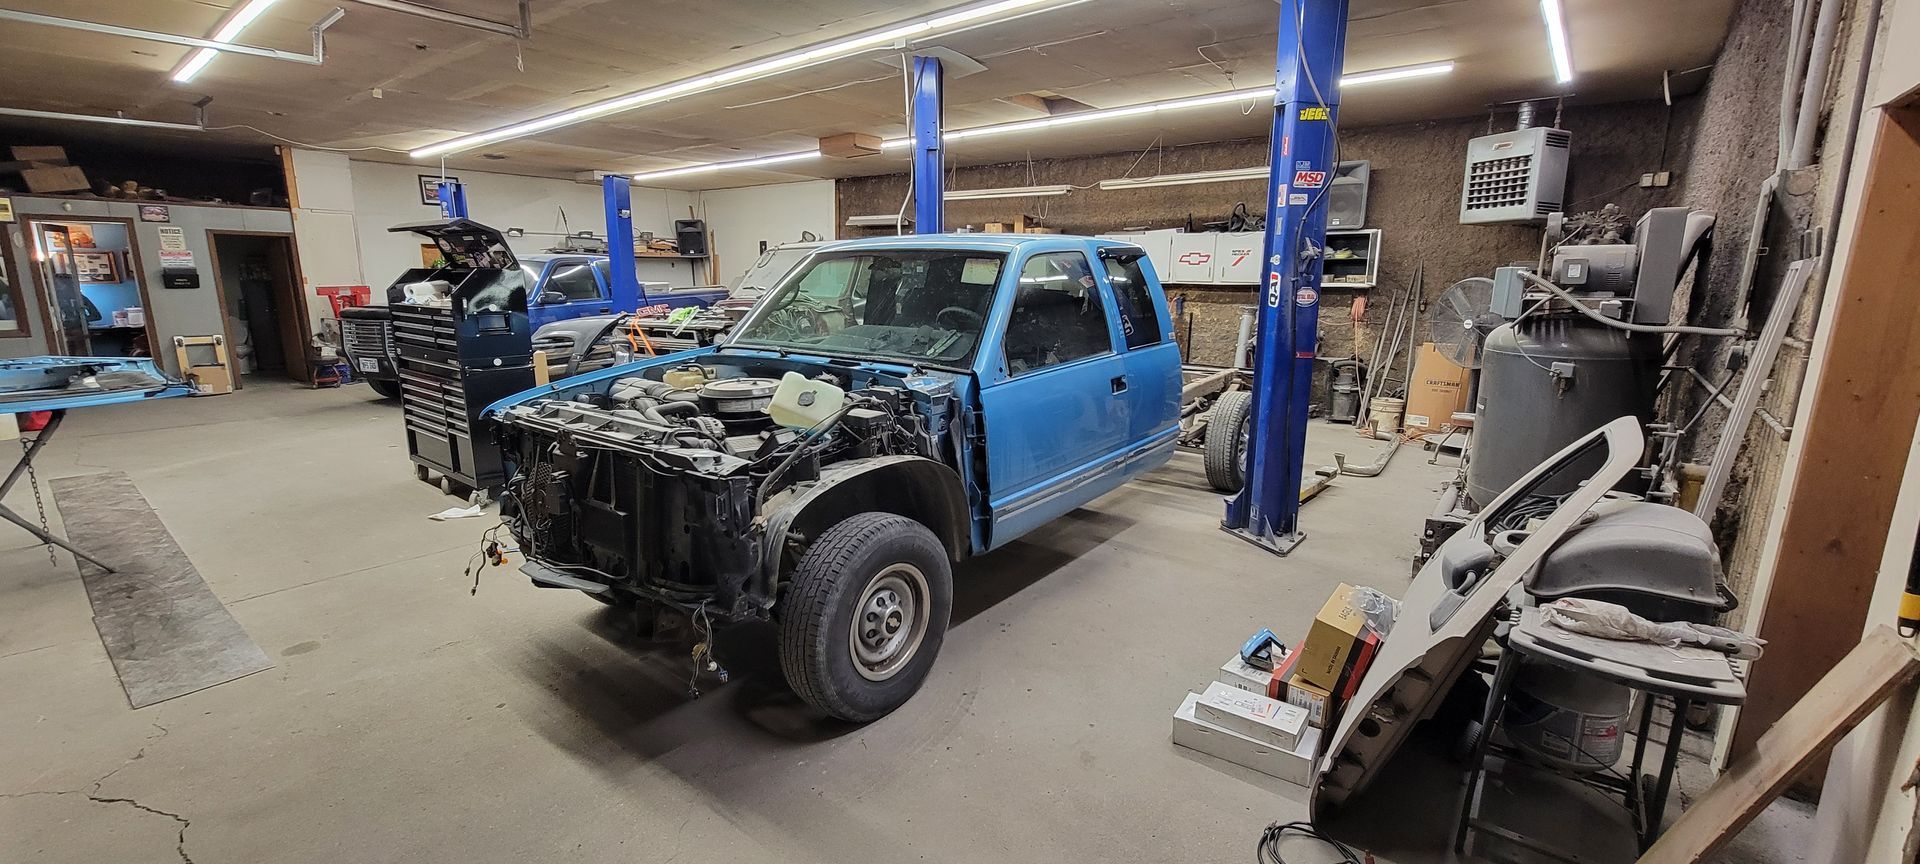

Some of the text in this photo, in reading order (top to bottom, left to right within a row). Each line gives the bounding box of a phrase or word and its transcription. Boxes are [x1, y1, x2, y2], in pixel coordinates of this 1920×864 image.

[1296, 173, 1323, 182] MSD
[637, 304, 671, 317] GMC
[1426, 379, 1461, 388] CRAFTSMAN
